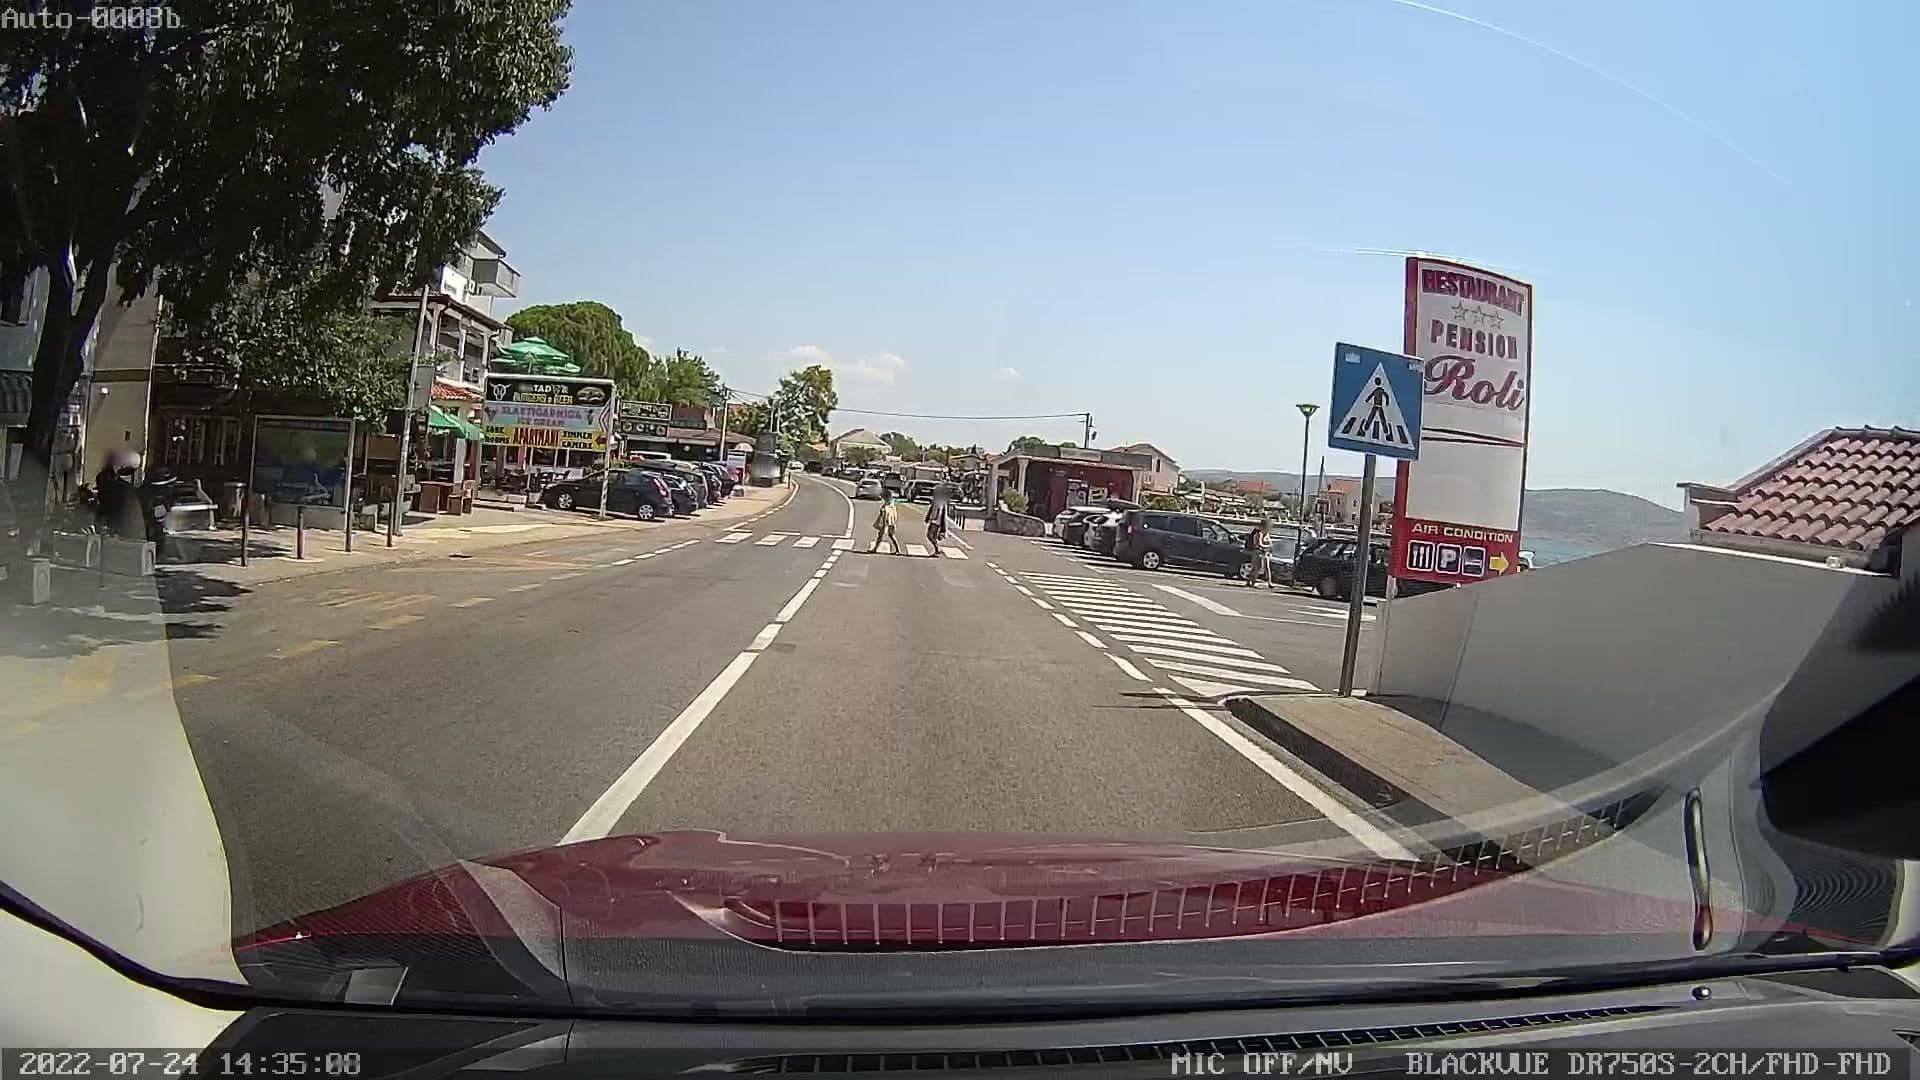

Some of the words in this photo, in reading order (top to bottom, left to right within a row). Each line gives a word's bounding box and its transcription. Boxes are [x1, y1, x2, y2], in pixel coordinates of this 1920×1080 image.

[1421, 268, 1525, 316] RESTAURANT
[1430, 319, 1518, 360] PENSION
[1424, 355, 1525, 411] Roli
[1411, 522, 1438, 536] AIR
[1443, 526, 1514, 544] CONDITION
[1440, 548, 1457, 569] P
